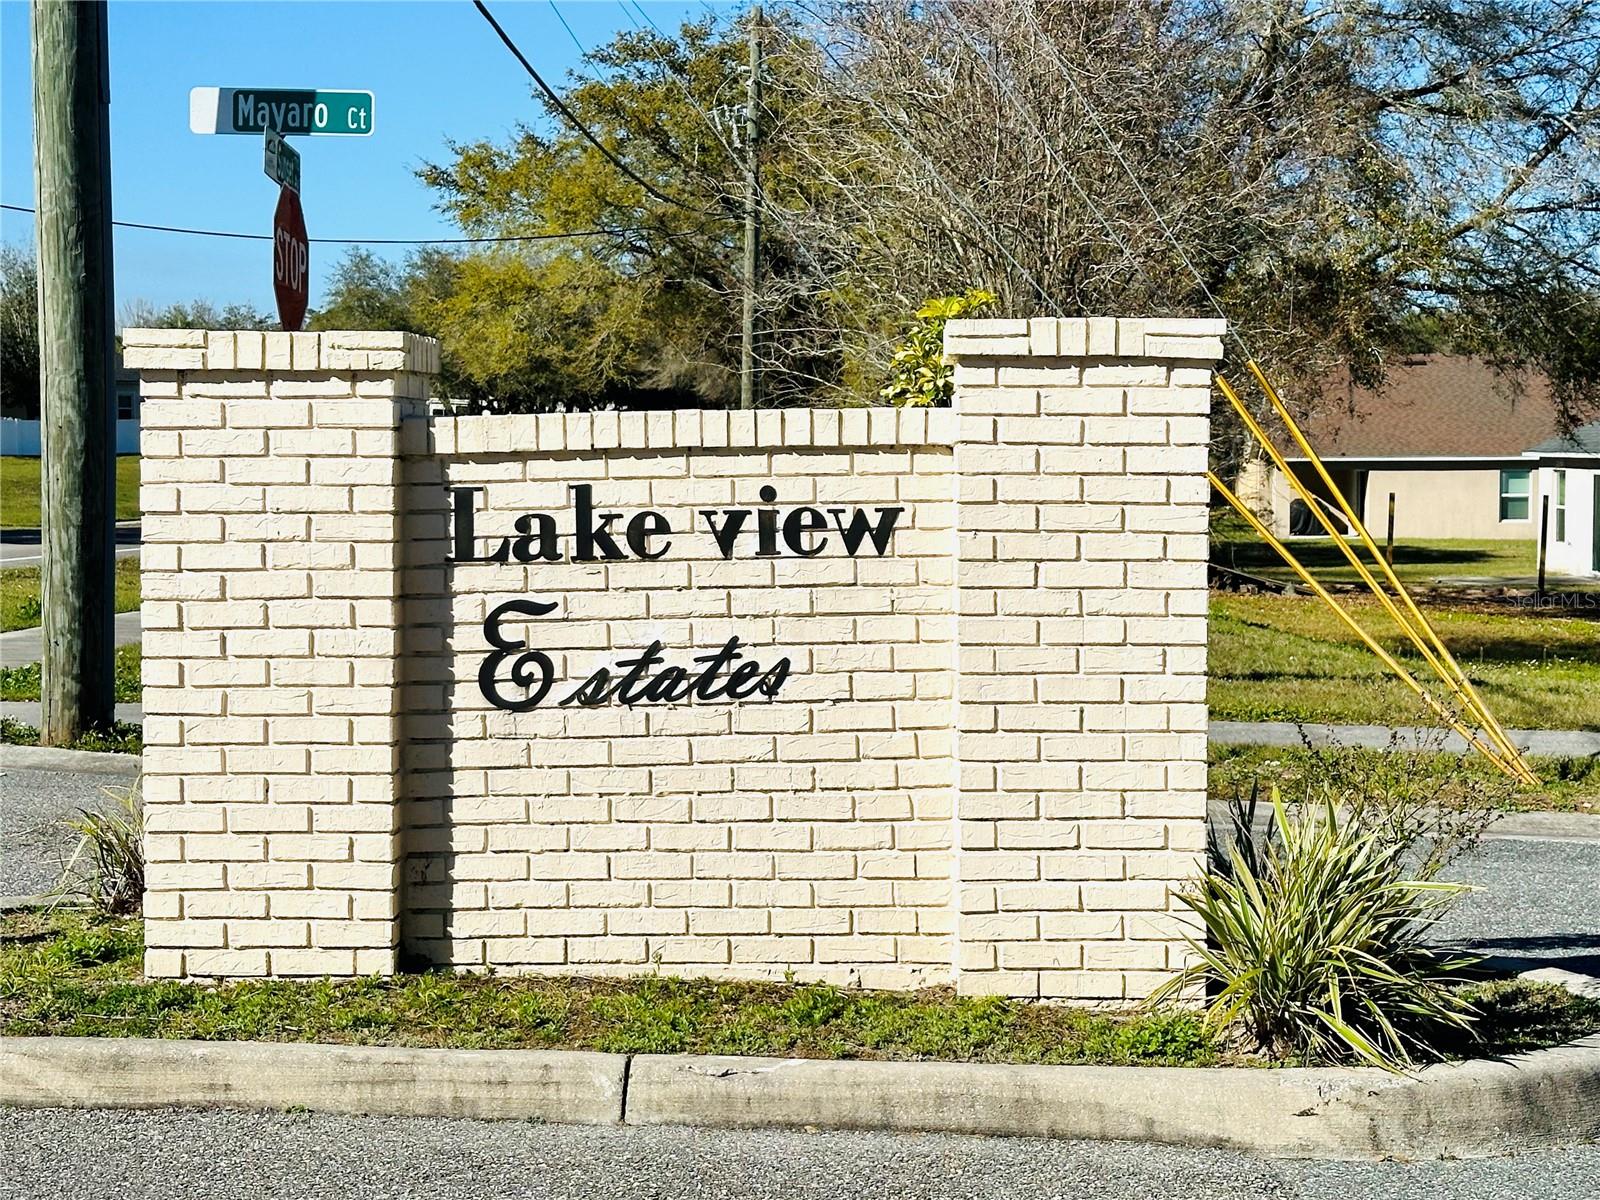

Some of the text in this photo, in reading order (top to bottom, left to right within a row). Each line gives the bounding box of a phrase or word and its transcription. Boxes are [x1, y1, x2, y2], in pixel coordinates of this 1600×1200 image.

[237, 94, 367, 132] Mayaro Ct
[275, 227, 307, 293] STOP
[445, 484, 905, 563] Lake view
[479, 599, 791, 712] Estates
